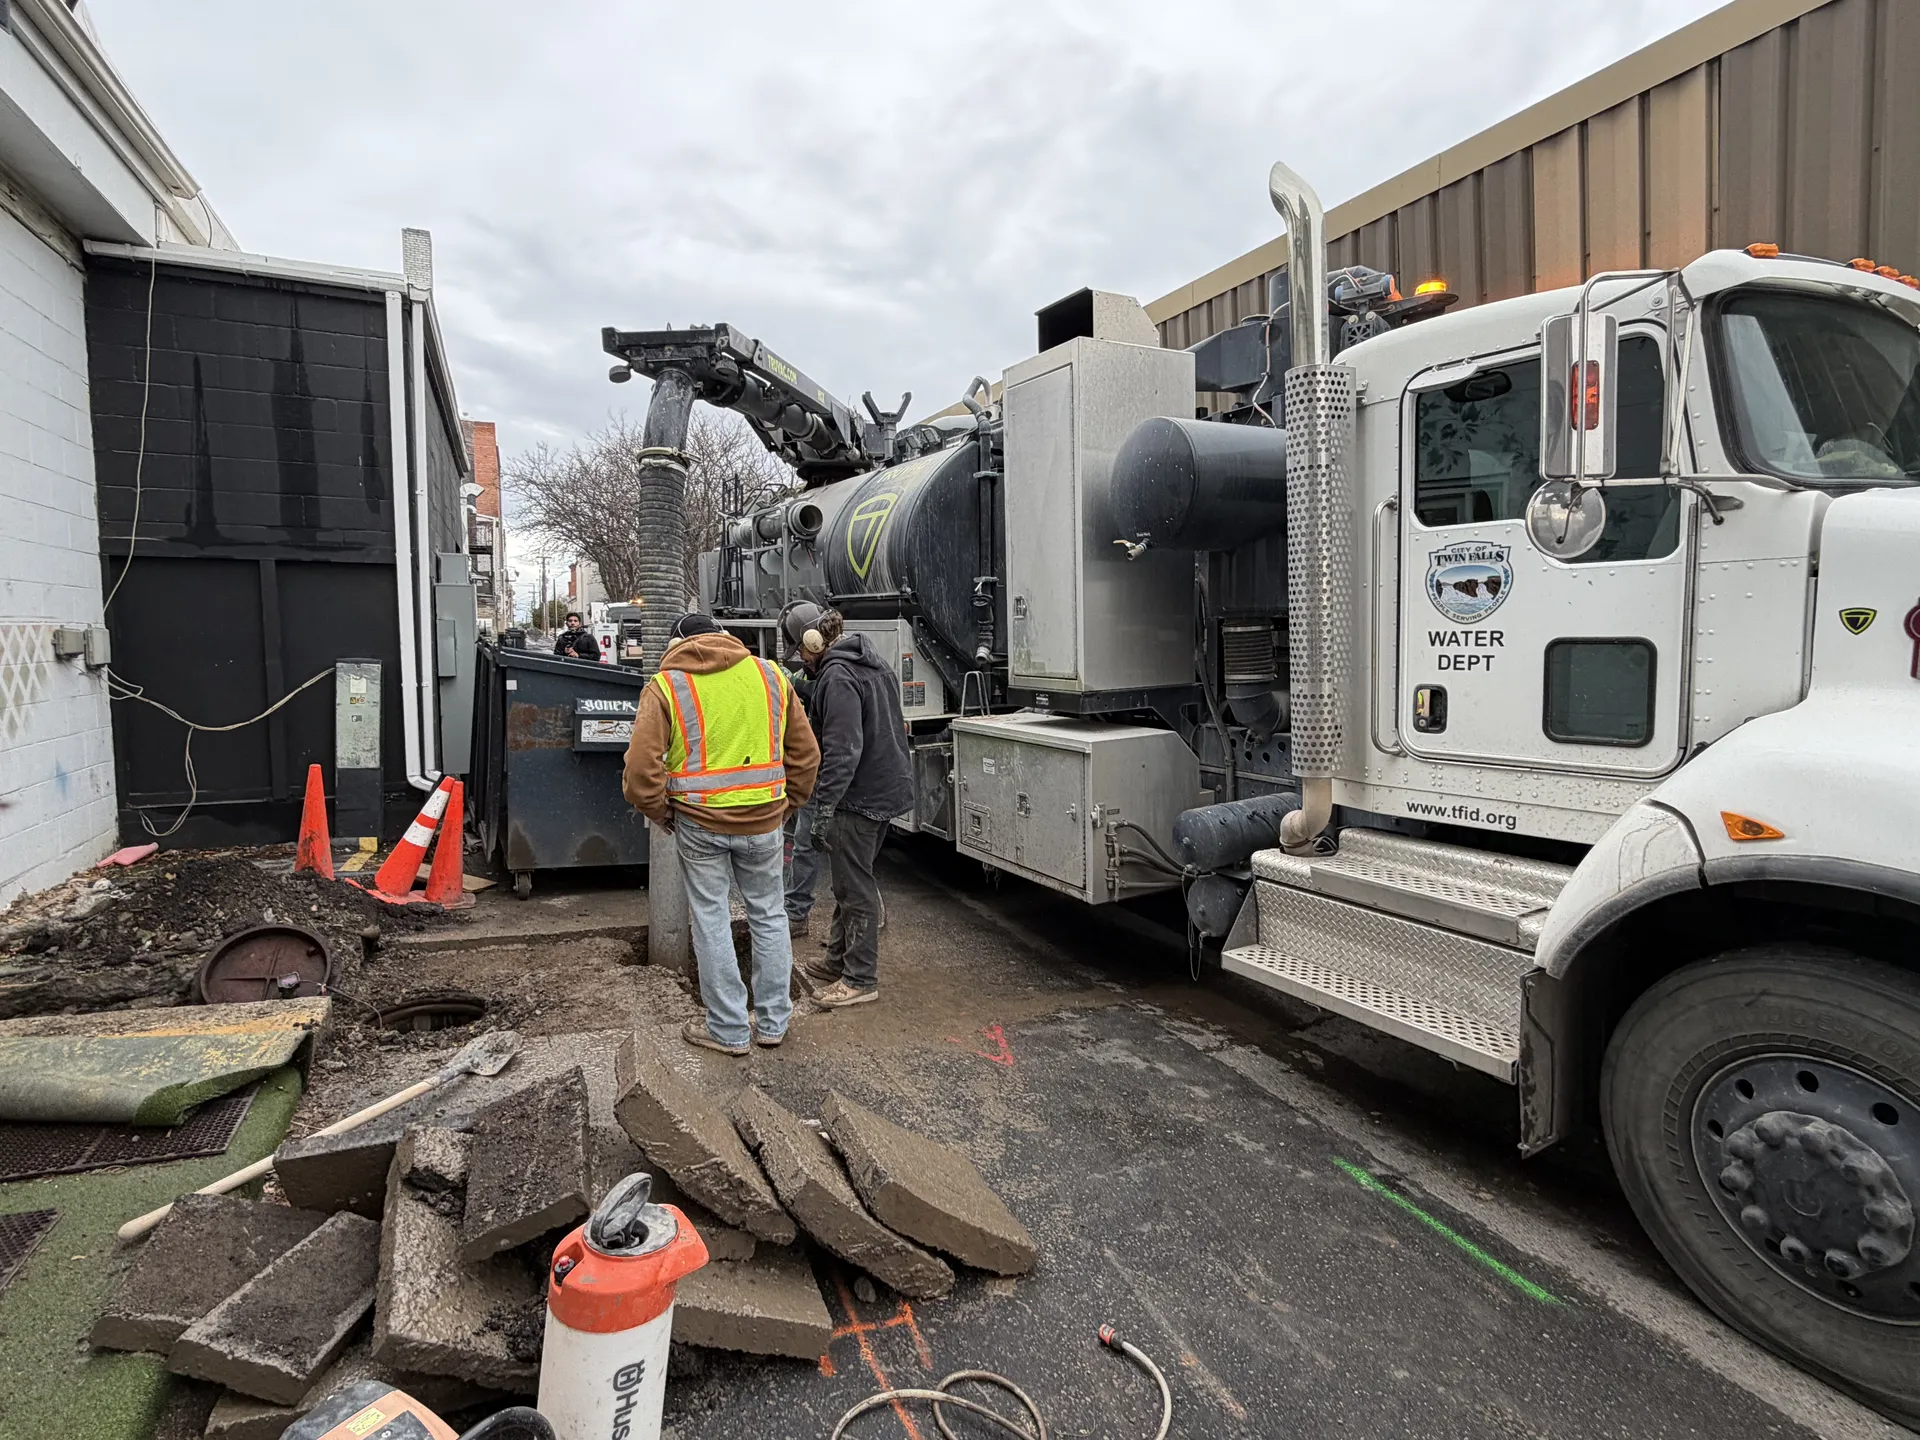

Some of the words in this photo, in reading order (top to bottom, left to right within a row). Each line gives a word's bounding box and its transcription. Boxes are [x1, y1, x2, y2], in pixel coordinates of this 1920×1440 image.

[1434, 552, 1466, 567] TWIN
[1469, 550, 1504, 563] FALLS
[1451, 546, 1470, 554] CITY
[1431, 592, 1450, 615] PEOPLE
[1452, 613, 1482, 621] SERVING
[1484, 590, 1507, 614] PEOPLE
[1428, 630, 1505, 647] WATER
[1437, 654, 1495, 671] DEPT
[1406, 801, 1517, 830] www.tfid.org
